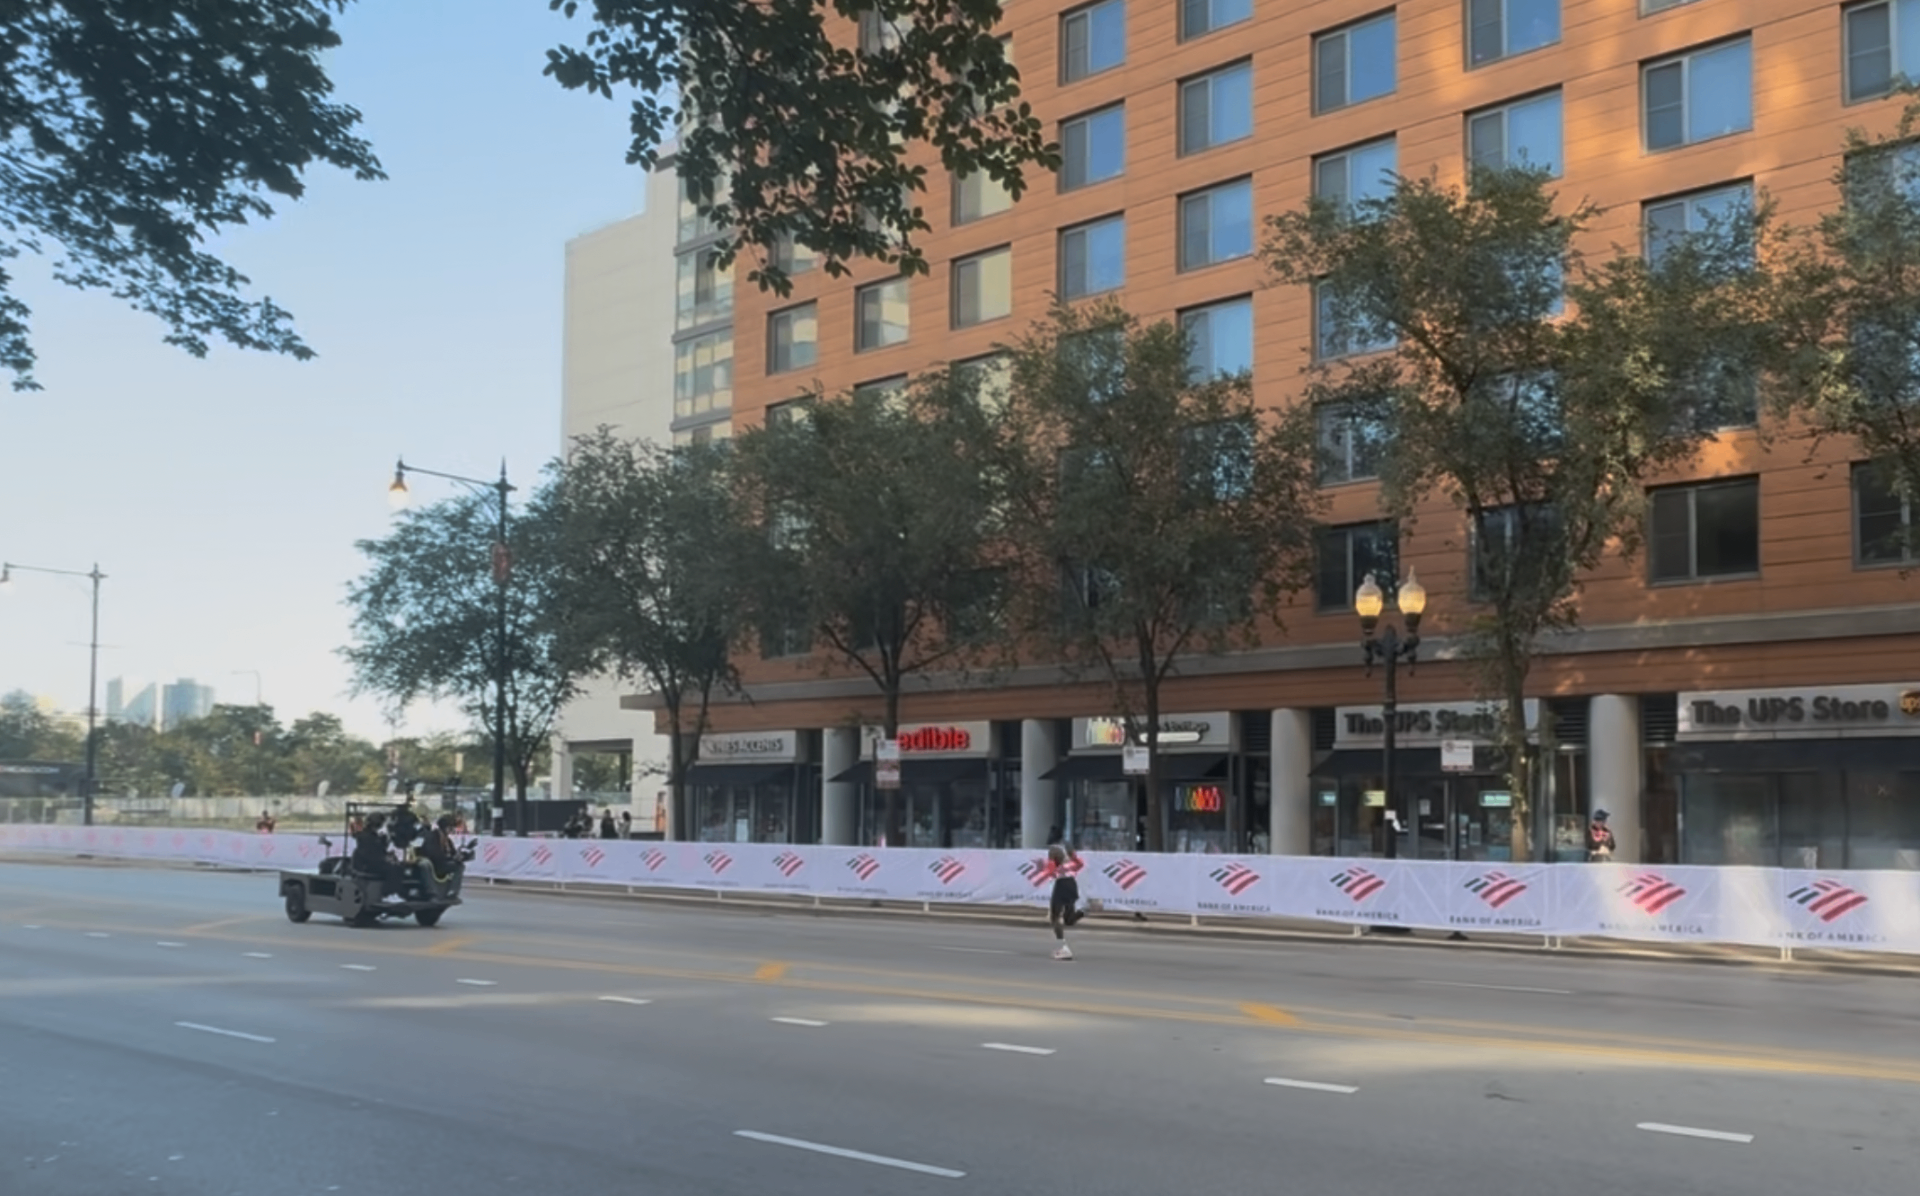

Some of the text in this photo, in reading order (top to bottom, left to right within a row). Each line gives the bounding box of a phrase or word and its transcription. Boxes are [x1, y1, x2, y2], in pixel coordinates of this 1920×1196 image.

[1691, 696, 1889, 724] The UPS Store
[1343, 713, 1384, 734] The
[899, 727, 970, 751] edible
[1449, 915, 1476, 924] BANK
[1494, 918, 1542, 926] AMERICA
